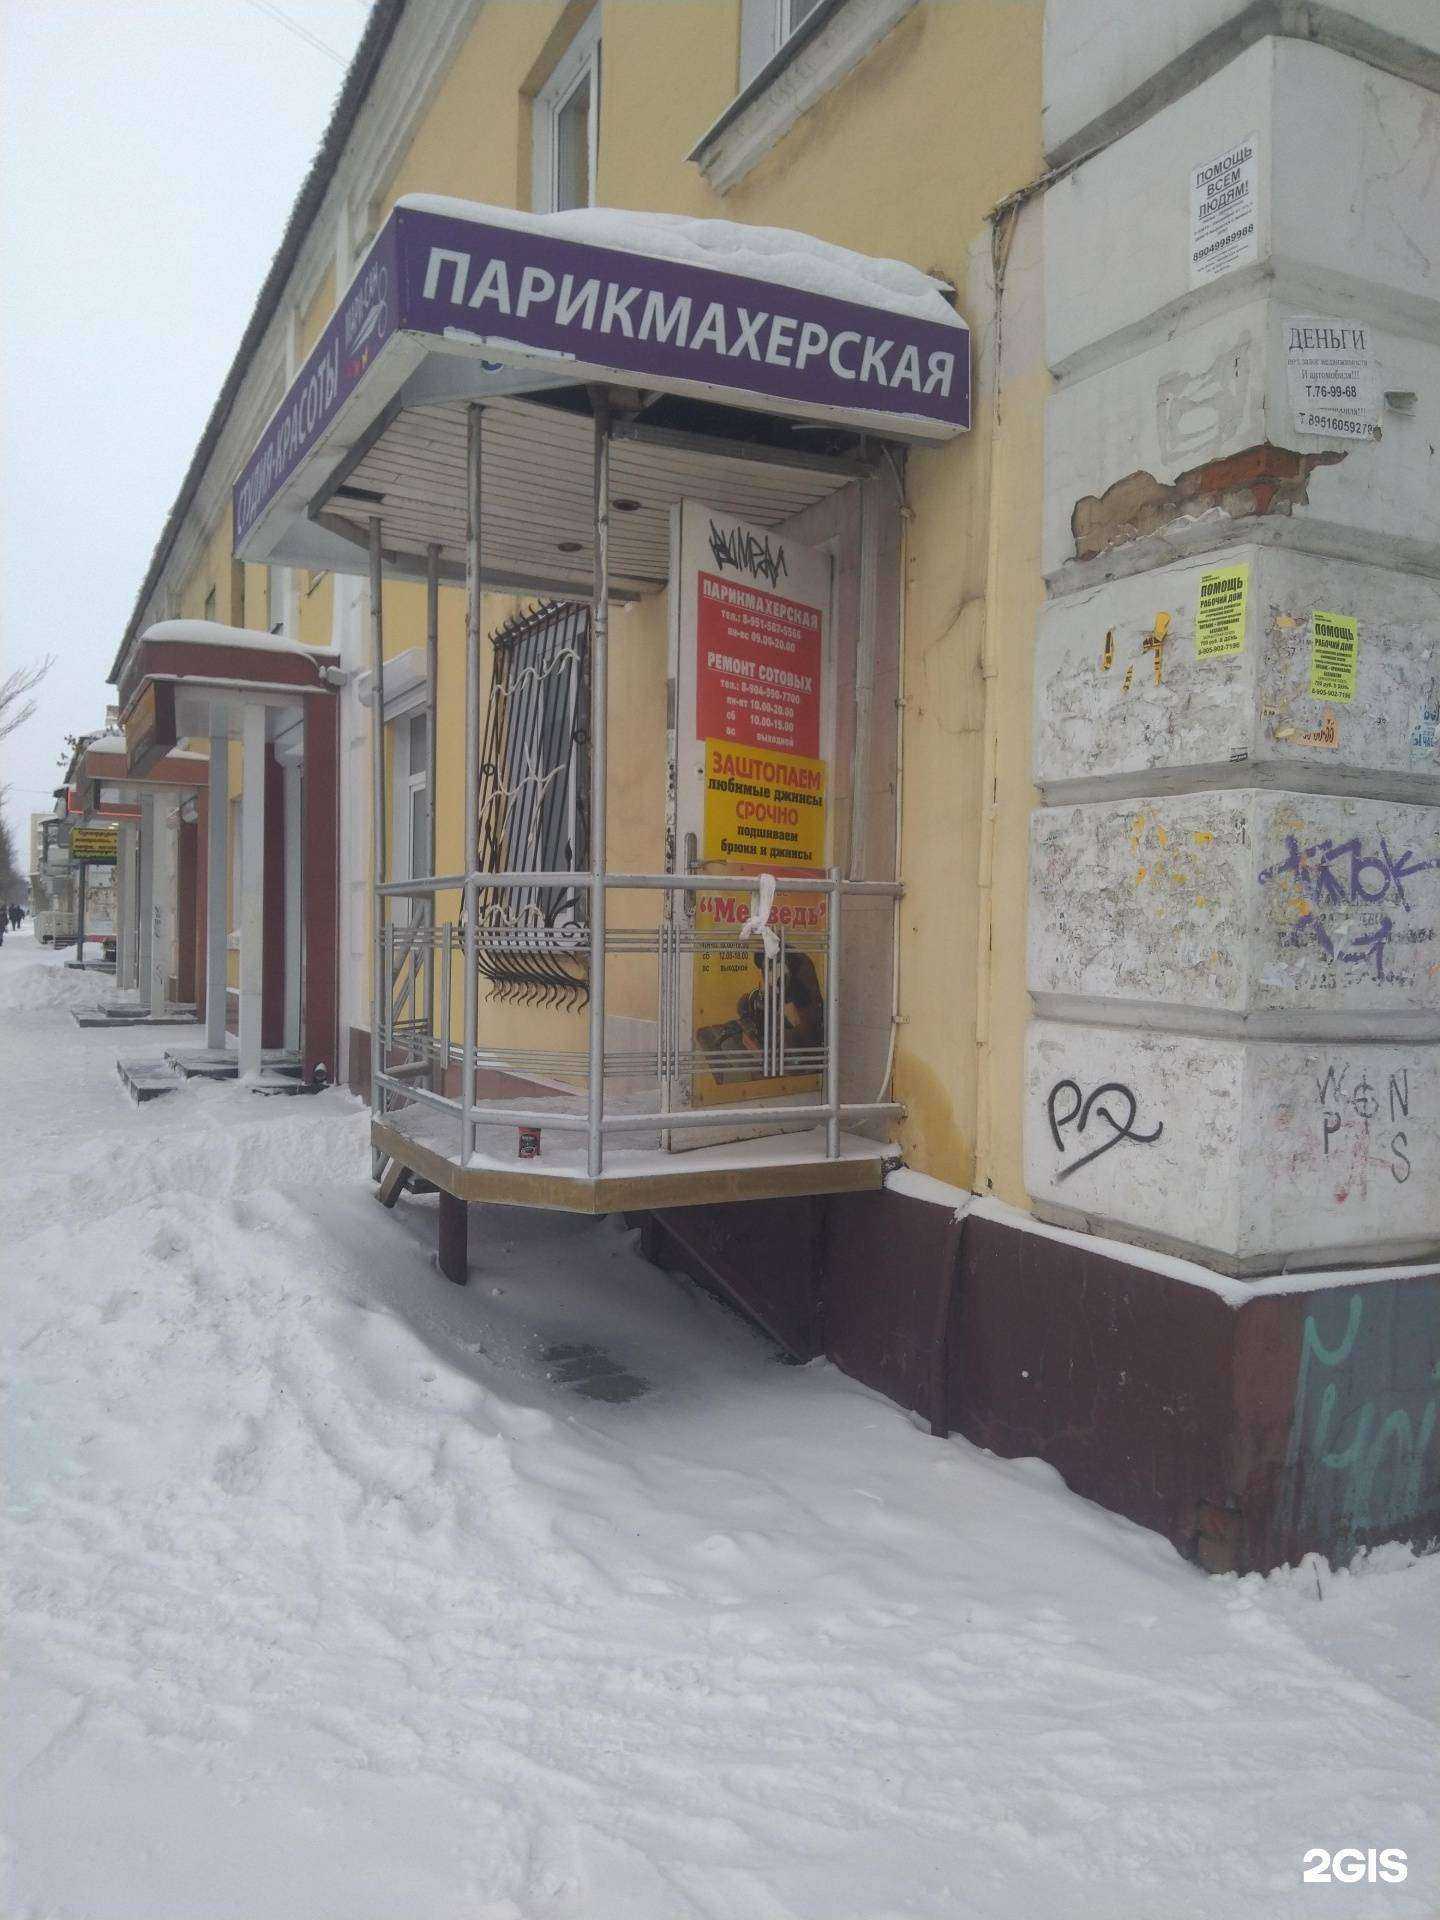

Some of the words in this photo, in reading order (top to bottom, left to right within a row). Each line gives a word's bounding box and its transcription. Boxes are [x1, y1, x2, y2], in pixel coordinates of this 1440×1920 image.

[1196, 147, 1253, 186] ПОМОЩЬ
[1207, 168, 1241, 196] ВСЕМ
[1199, 180, 1249, 217] ЛЮДЯМ!
[422, 246, 956, 398] ПАРИКМАХЕРСКАЯ
[1288, 327, 1366, 352] ДЕНЬГИ
[1200, 577, 1243, 597] ПОМОЩЬ
[703, 578, 819, 629] ПАРИКМАХЕРСКАЯ
[1315, 623, 1354, 641] ПОМОЩЬ
[707, 651, 756, 677] РЕМОНТ
[758, 664, 813, 692] СОТОВЫХ
[712, 751, 821, 790] ЗАШТОПАЕМ
[708, 777, 771, 798] любимые
[774, 788, 823, 807] джинсы
[736, 800, 799, 825] СРОЧНО
[737, 825, 798, 842] подшиваем
[720, 839, 757, 855] брюки
[759, 846, 767, 855] и
[769, 848, 813, 861] джинсы
